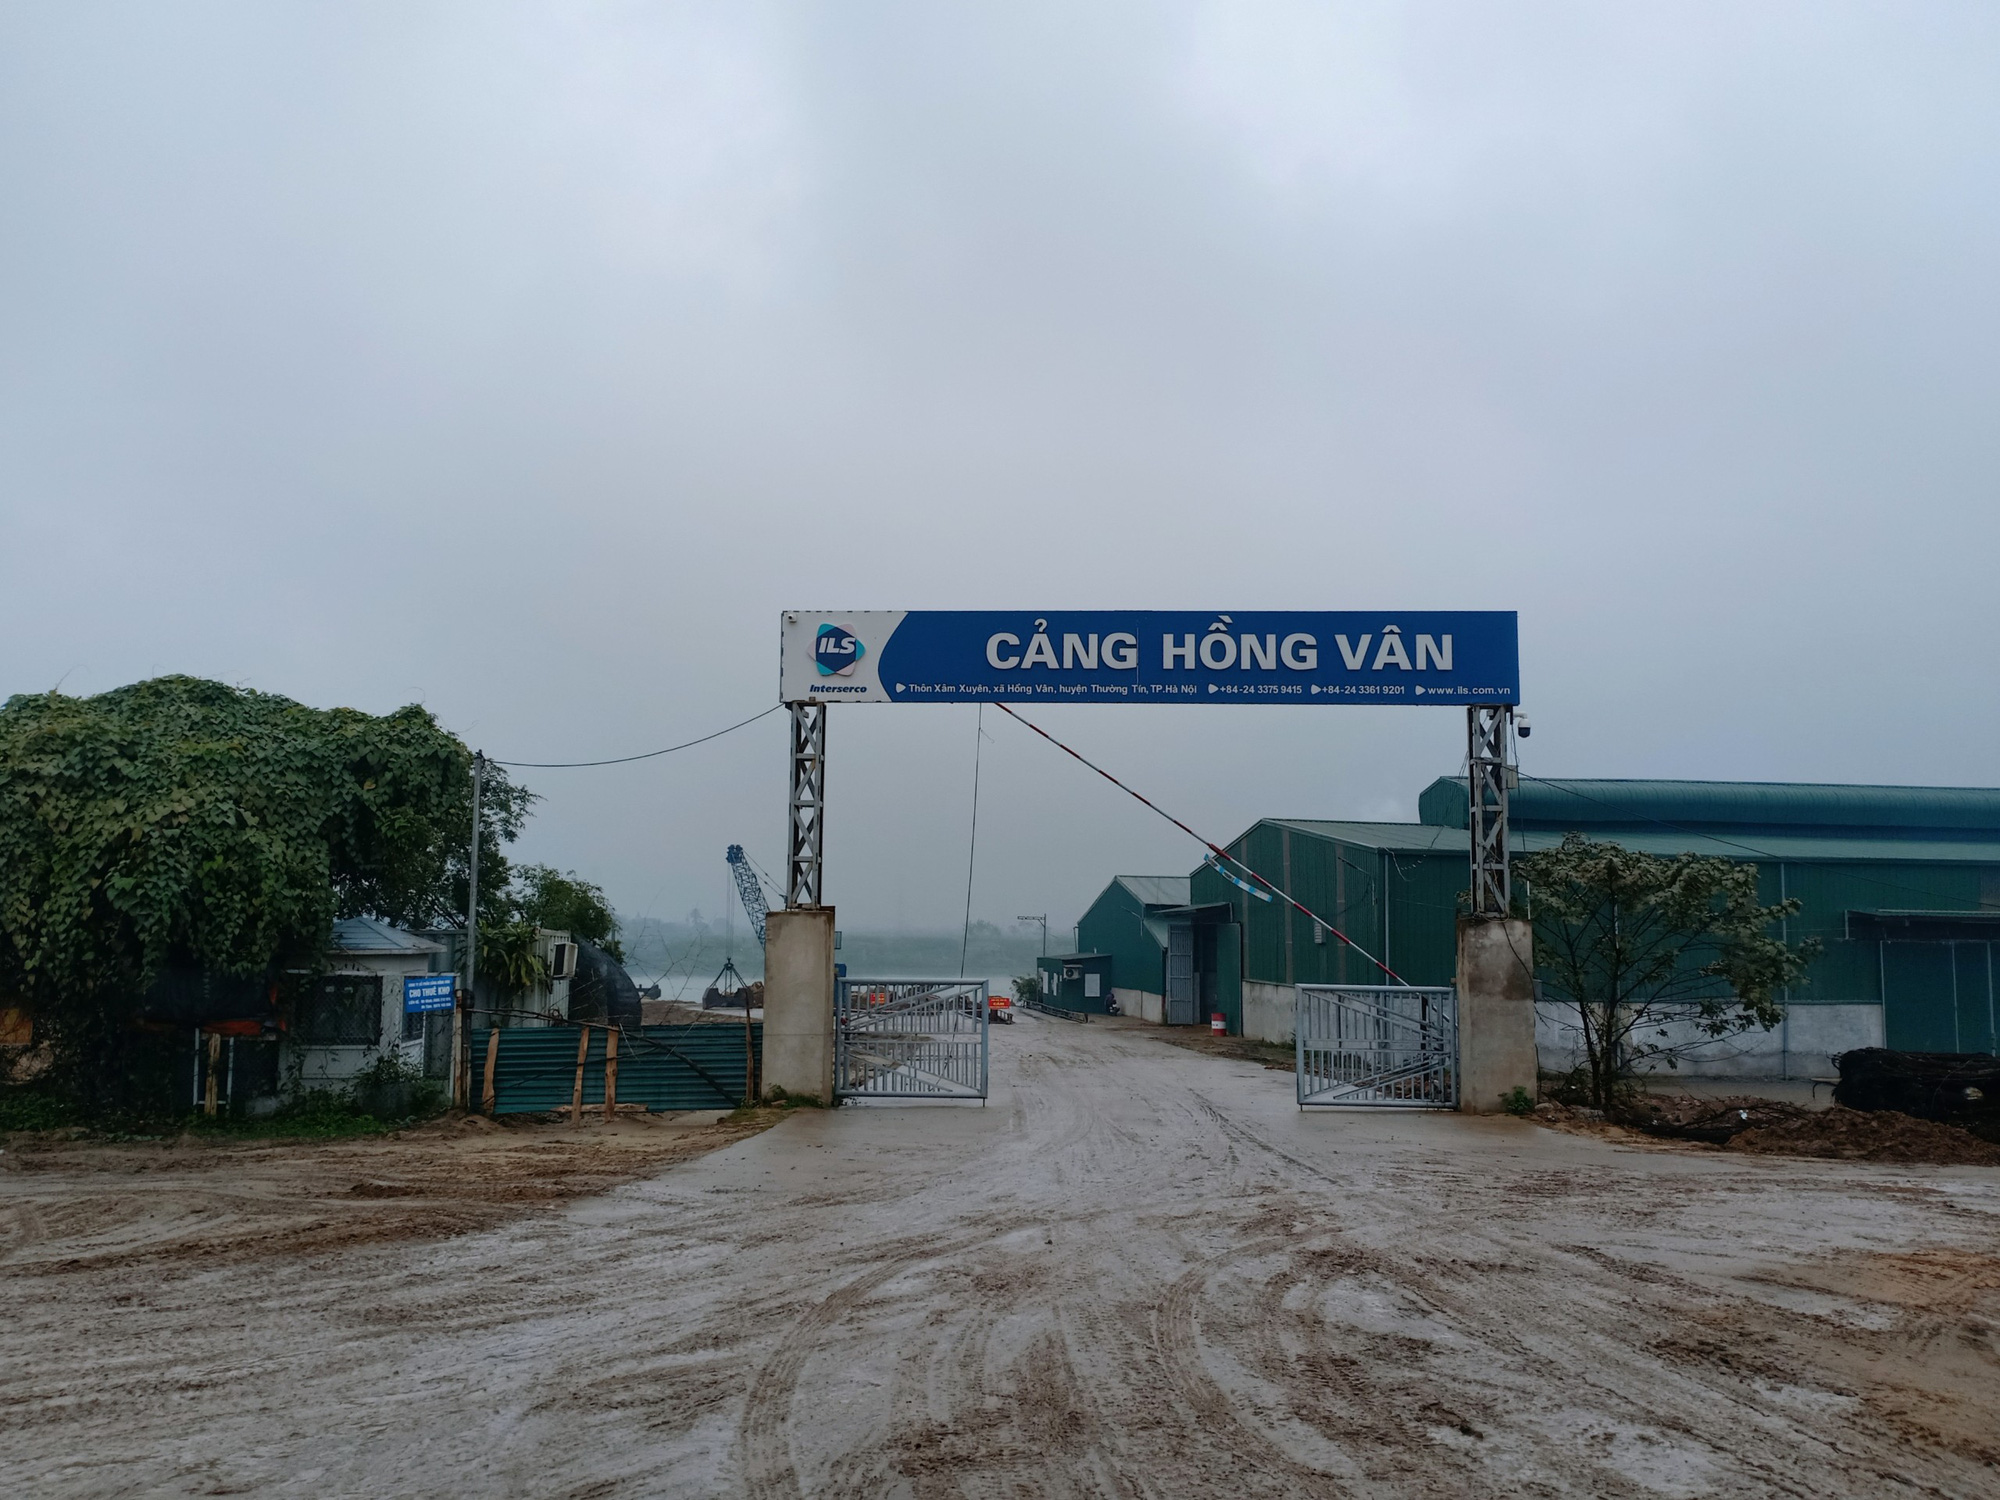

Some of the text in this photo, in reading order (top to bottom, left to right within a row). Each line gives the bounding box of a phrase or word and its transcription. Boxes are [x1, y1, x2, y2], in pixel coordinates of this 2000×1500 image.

[819, 637, 855, 654] ILS
[987, 616, 1452, 669] CẢNG HỒNG VÂN
[809, 684, 867, 693] Interserco
[908, 683, 932, 693] Thôn
[934, 683, 956, 693] Xâm
[959, 684, 991, 695] Xuyên,
[993, 684, 1005, 693] xã
[1035, 684, 1057, 694] Vân,
[1059, 684, 1088, 695] huyện
[1090, 684, 1128, 696] Thường
[1181, 684, 1197, 694] Nội
[1220, 685, 1302, 694] +84-24 3375 9415
[1322, 685, 1405, 694] +84-24 3361 9201
[1427, 686, 1511, 695] www.ils.com.vn
